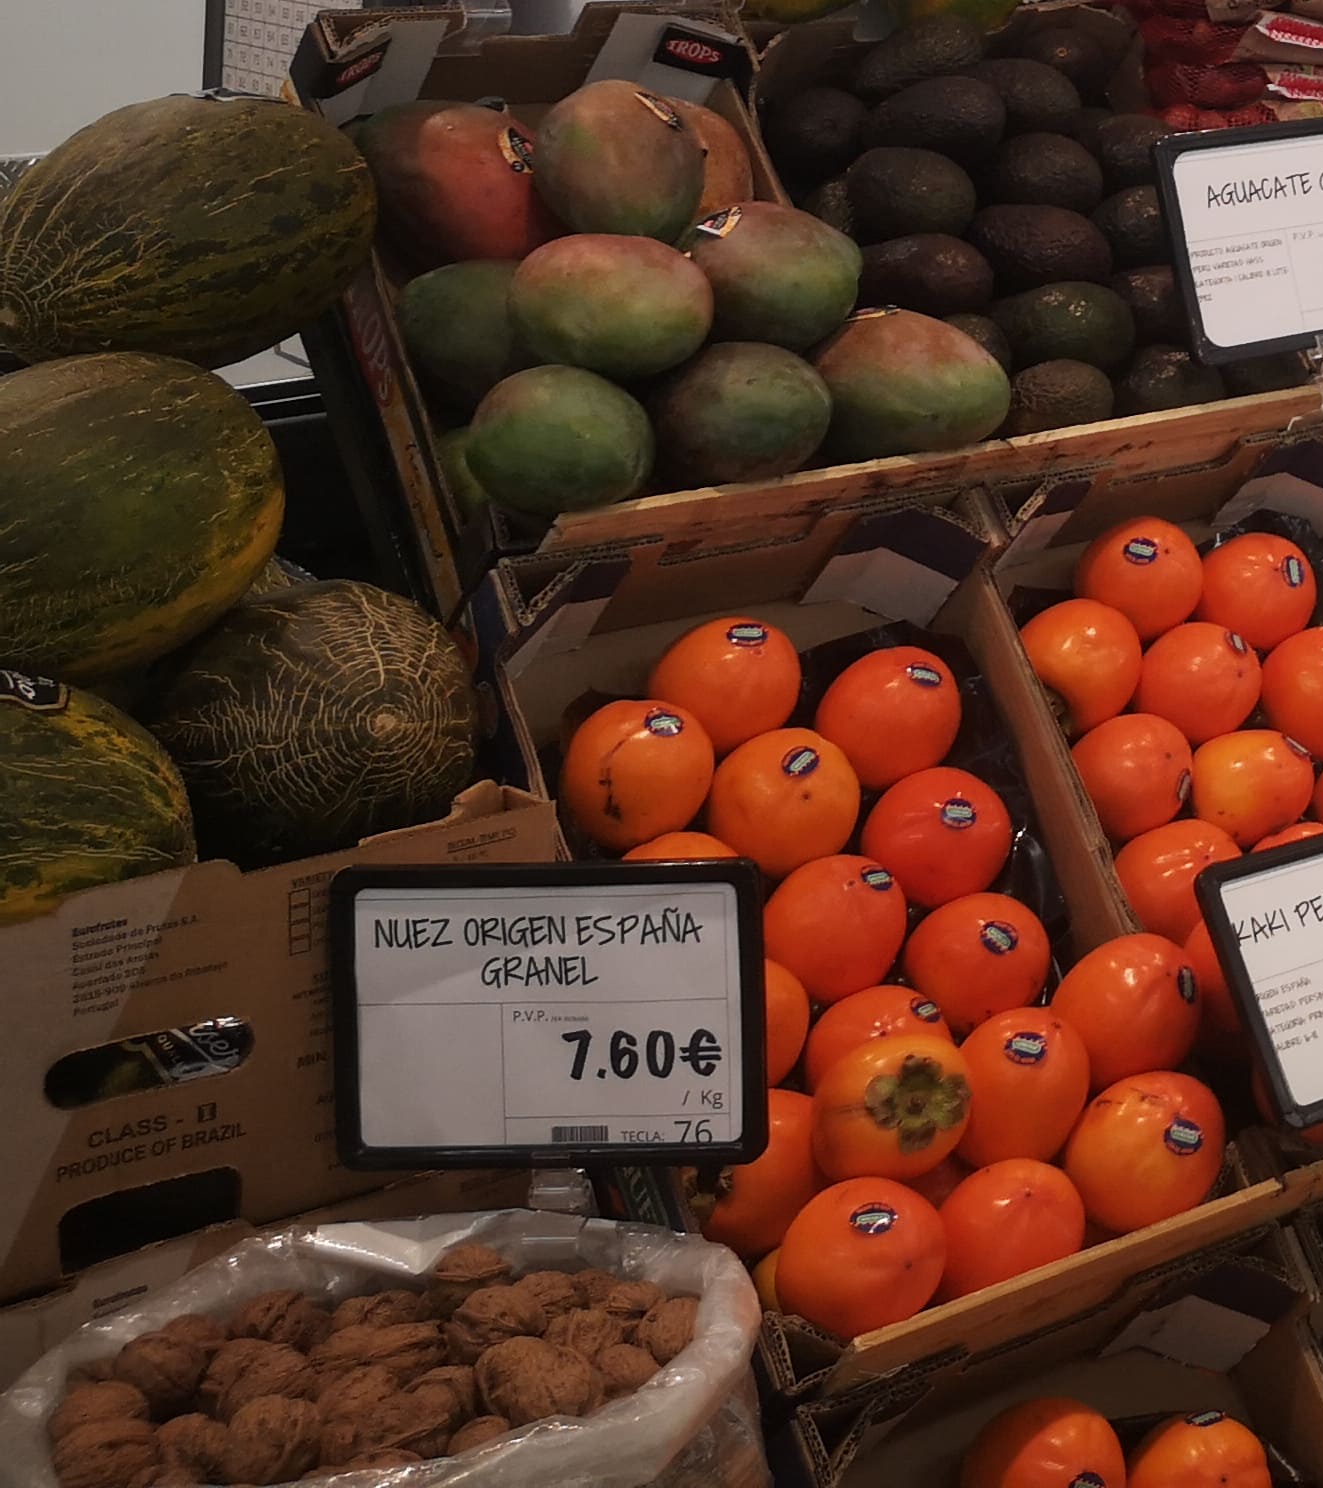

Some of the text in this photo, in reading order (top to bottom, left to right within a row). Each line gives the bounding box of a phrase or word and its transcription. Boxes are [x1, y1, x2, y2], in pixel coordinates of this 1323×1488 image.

[1206, 172, 1311, 209] AGUACATE
[374, 908, 704, 950] NUEZ ORIGEN ESPAÑA
[1231, 908, 1290, 947] KAKI
[481, 955, 599, 989] GRANEL
[513, 1010, 549, 1023] P.V.P.
[562, 1028, 722, 1081] 7.60€
[701, 1089, 724, 1110] Kg
[87, 1114, 168, 1149] CLASS
[620, 1119, 713, 1144] TECLA: 76
[56, 1122, 247, 1183] PRODUCE OF BRAZIL
